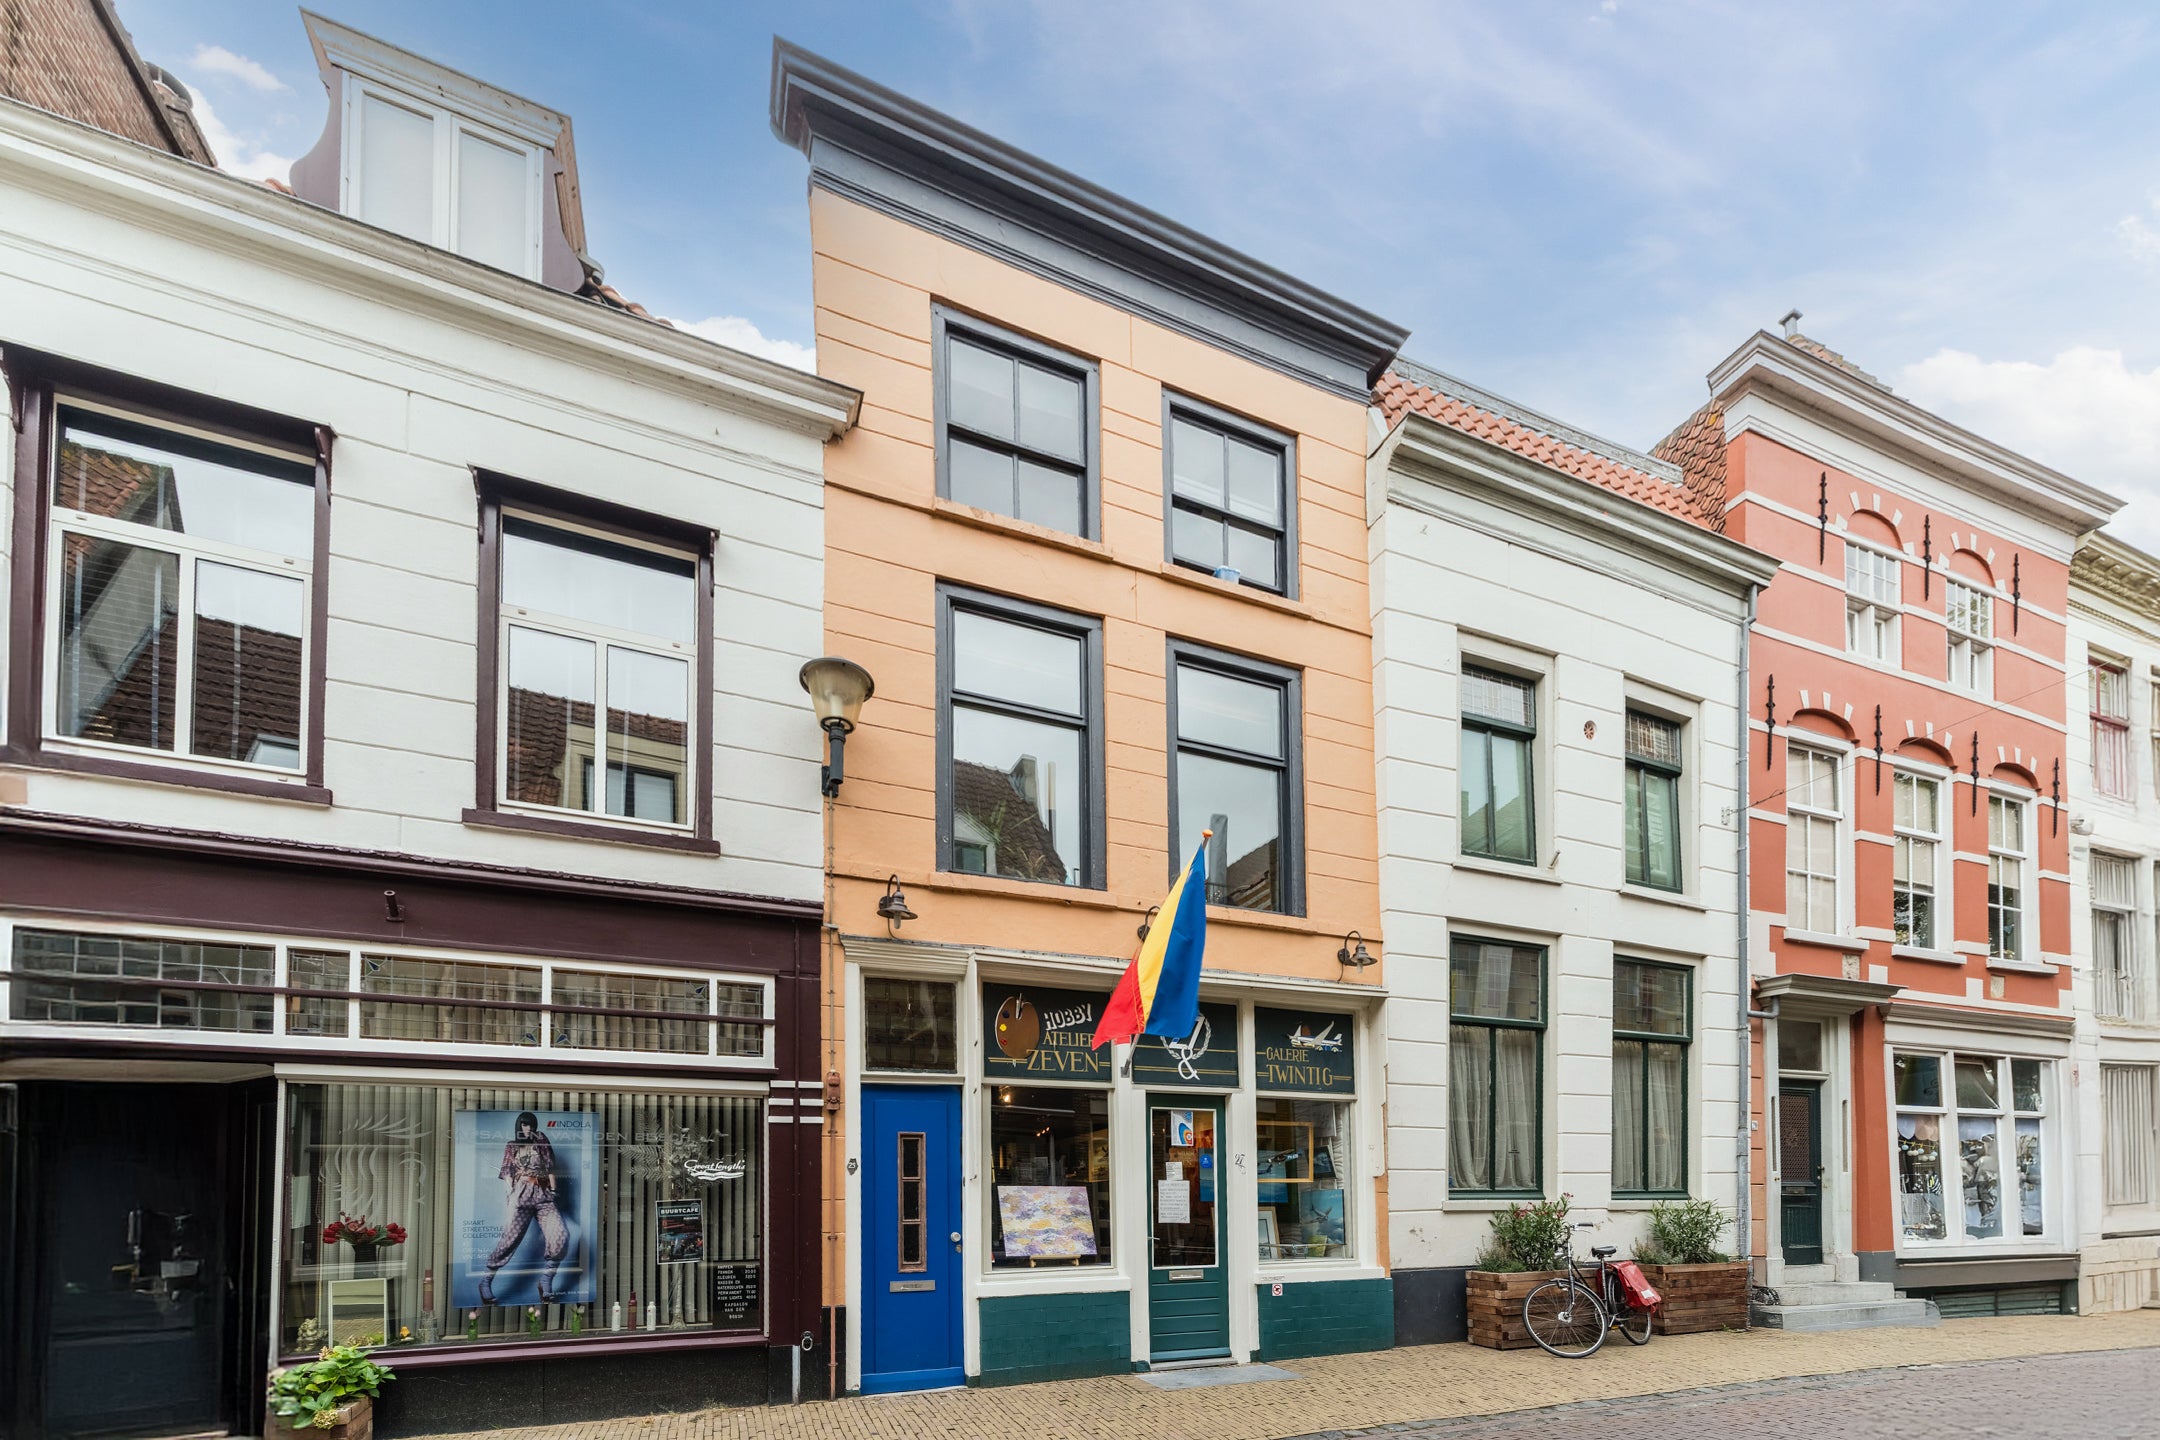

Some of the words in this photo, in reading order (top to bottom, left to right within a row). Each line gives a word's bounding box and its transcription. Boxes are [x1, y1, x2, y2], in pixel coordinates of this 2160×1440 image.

[1043, 1003, 1093, 1031] HOBBY
[1026, 1049, 1099, 1073] ZEVEN
[1266, 1046, 1310, 1063] GALERIE
[1177, 1047, 1200, 1080] &
[1266, 1064, 1334, 1086] TWINTIG
[556, 1120, 592, 1129] INDOLA
[551, 1131, 585, 1141] VAN
[593, 1131, 628, 1142] DEN
[462, 1225, 505, 1233] STREETSTYLE
[462, 1231, 506, 1240] COLLECTION
